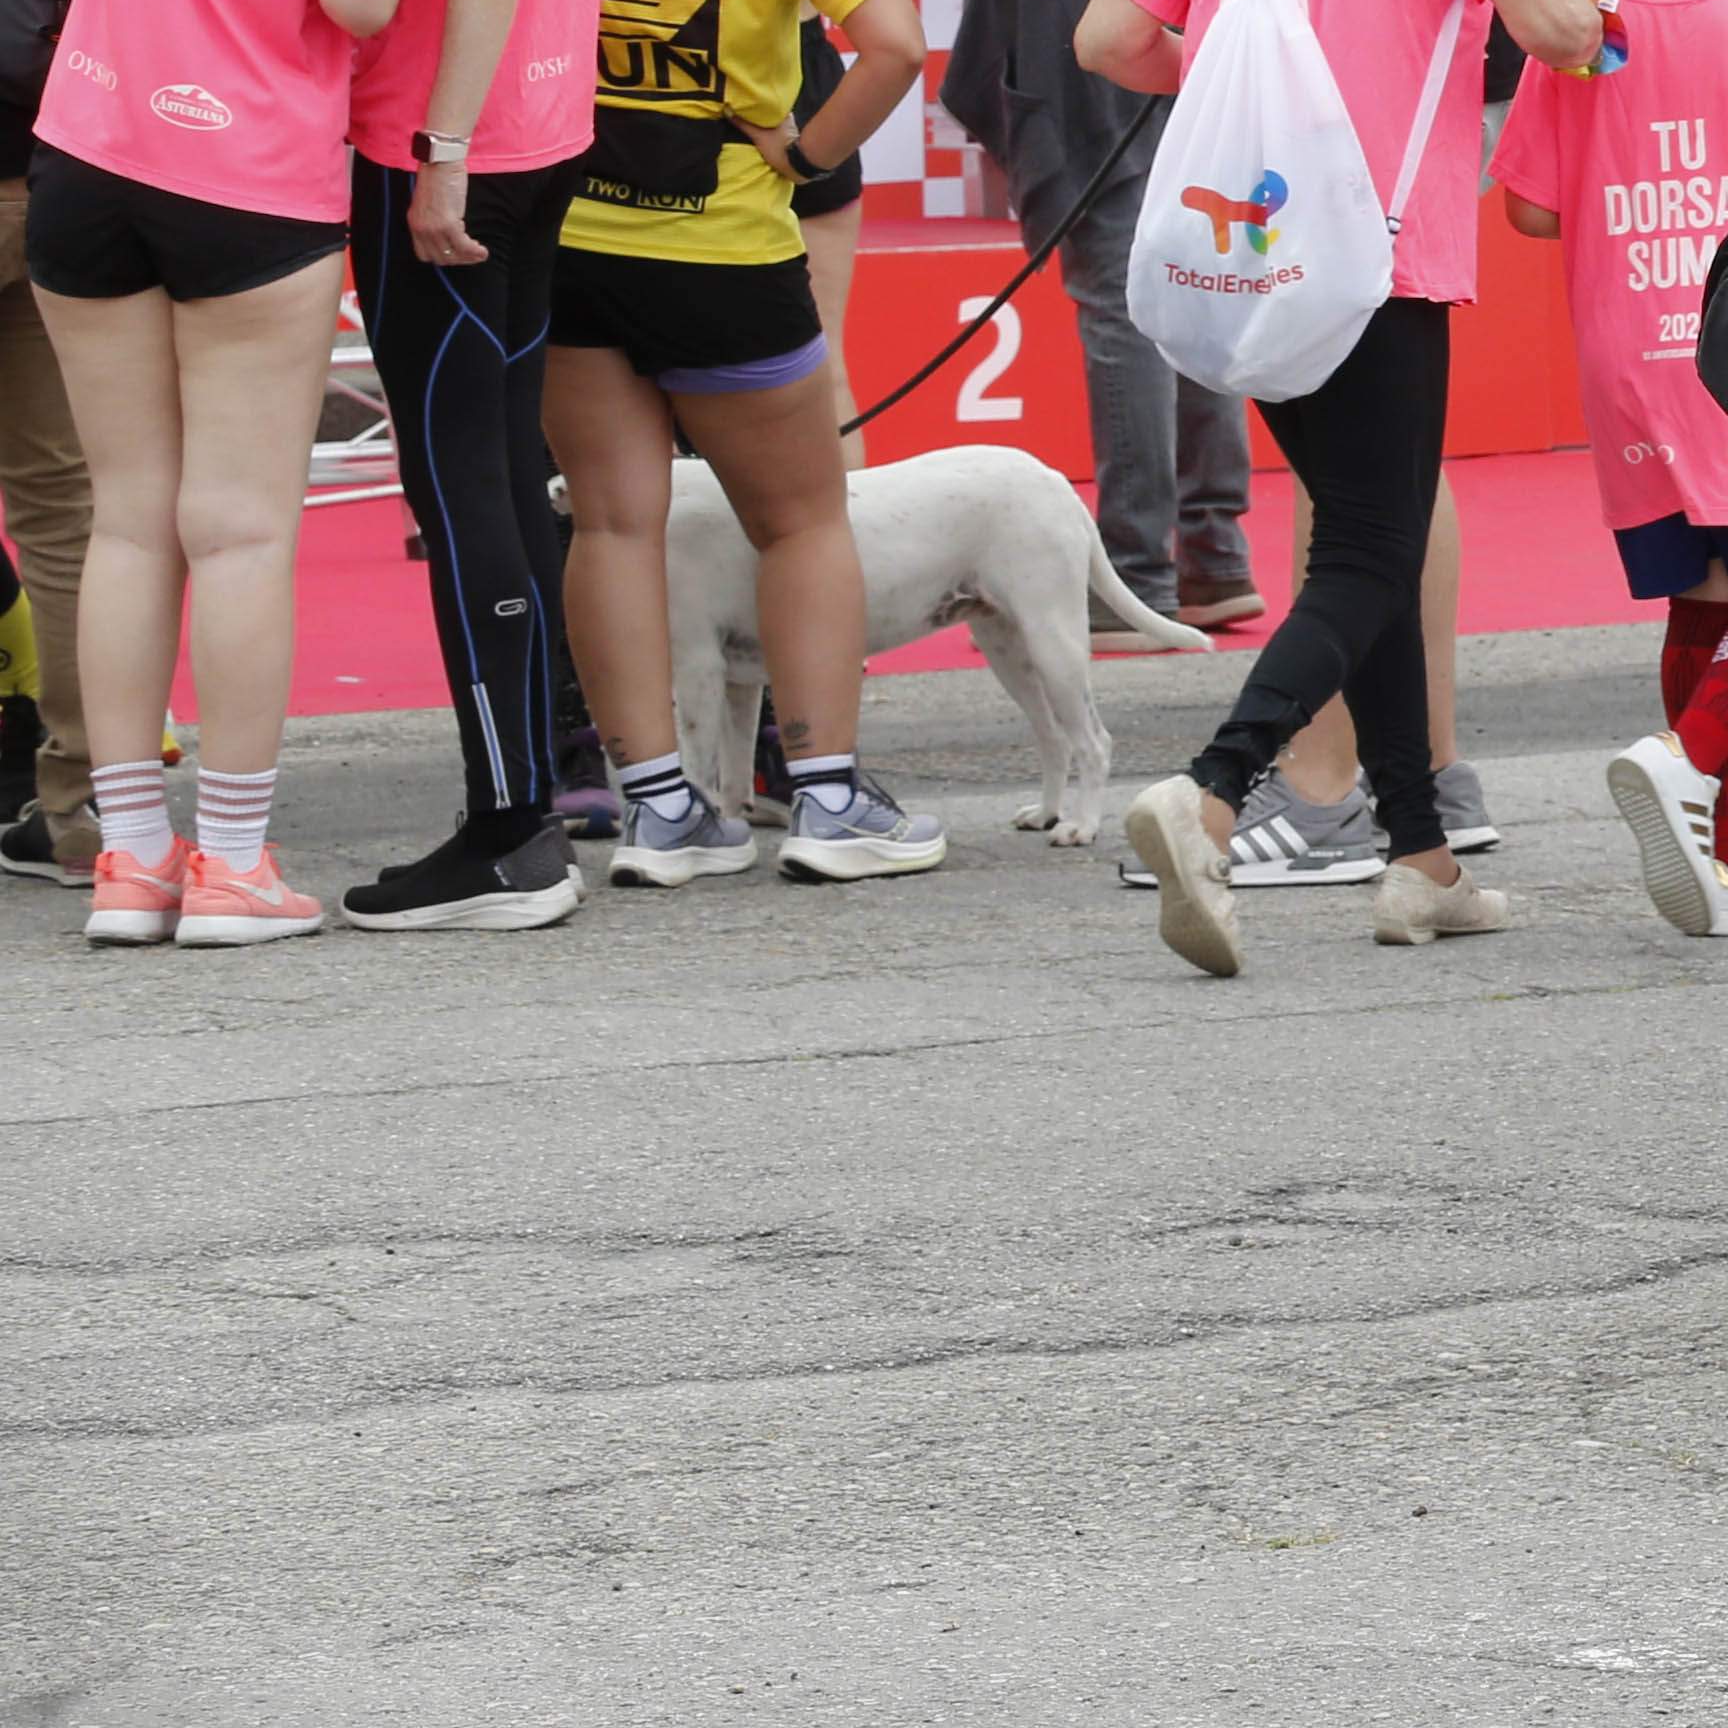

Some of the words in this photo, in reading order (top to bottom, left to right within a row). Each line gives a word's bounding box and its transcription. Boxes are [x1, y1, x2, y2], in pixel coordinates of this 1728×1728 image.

[598, 34, 712, 93] UN
[1650, 118, 1707, 172] TU
[1627, 235, 1719, 292] SUM
[1659, 311, 1700, 343] 202
[956, 295, 1024, 422] 2
